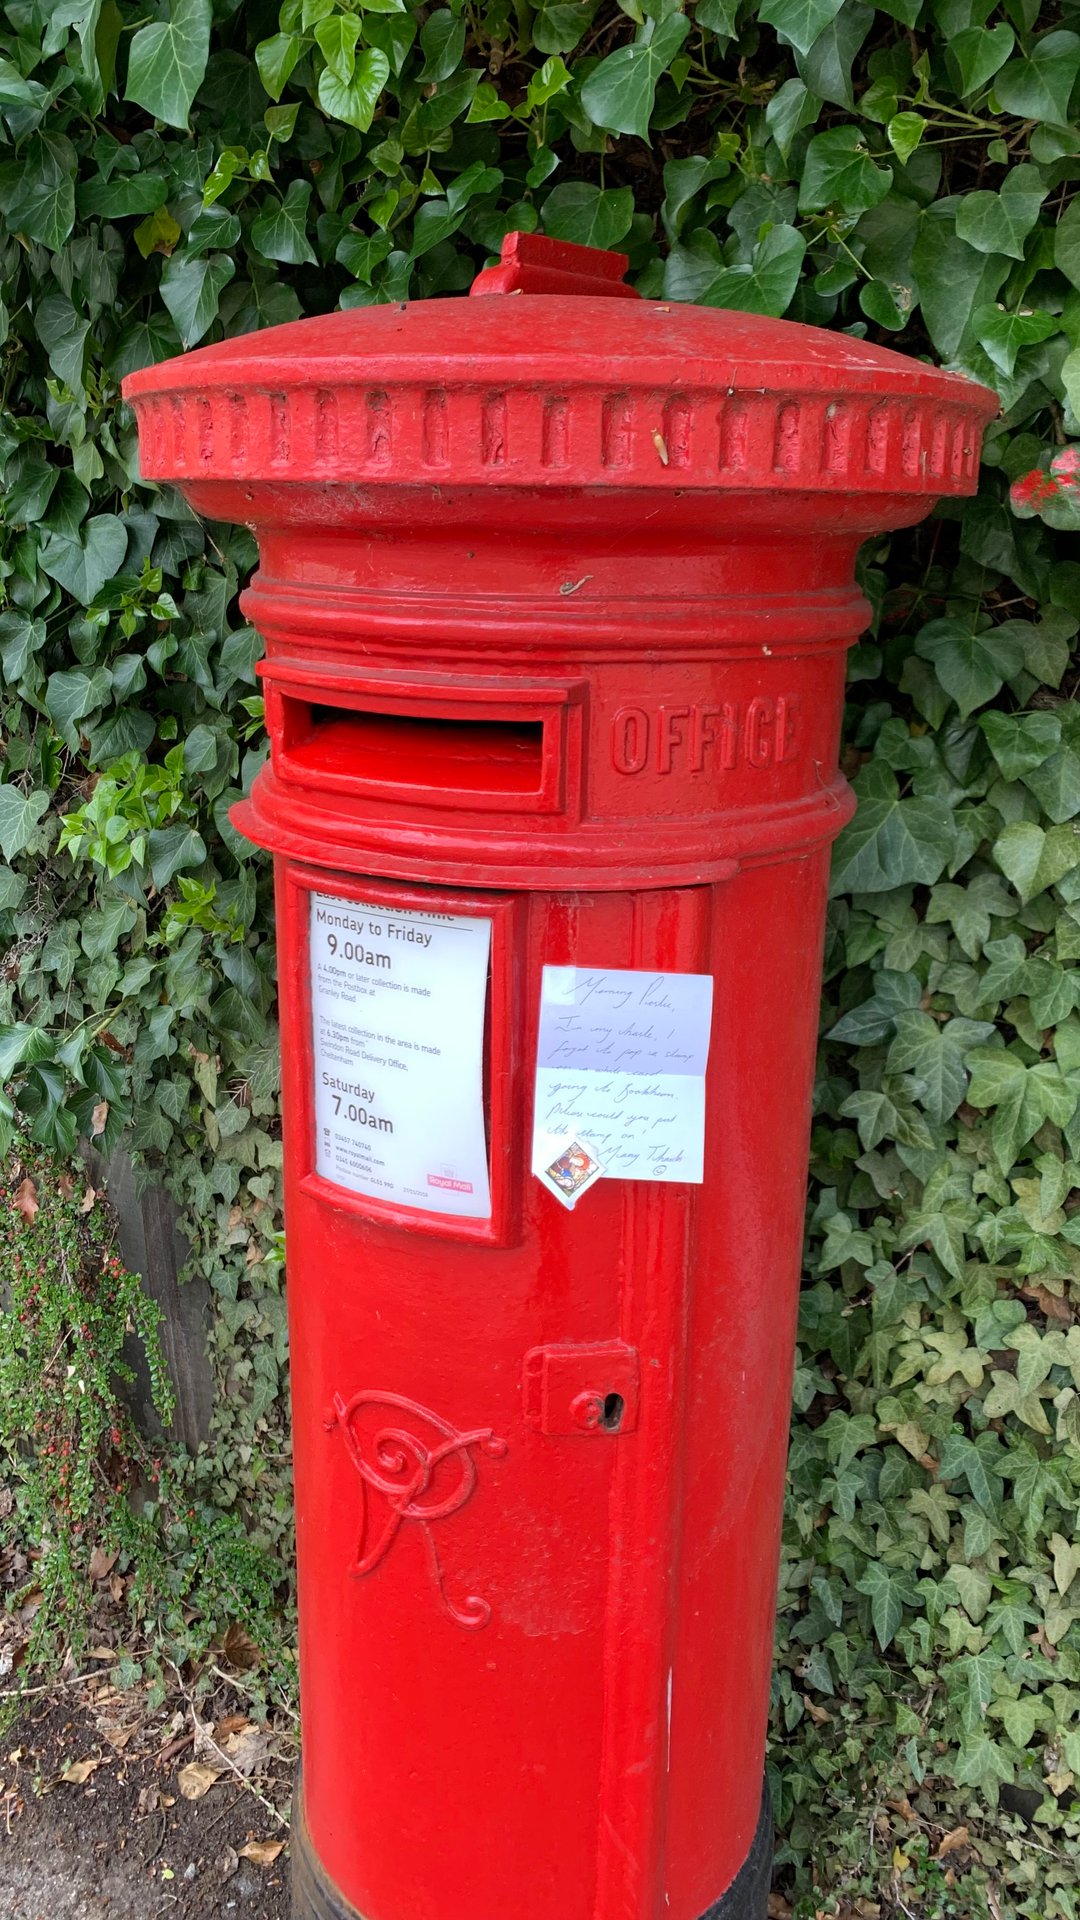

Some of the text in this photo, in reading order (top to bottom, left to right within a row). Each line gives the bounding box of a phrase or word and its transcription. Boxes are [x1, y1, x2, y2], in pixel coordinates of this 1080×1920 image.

[610, 696, 799, 775] OFFICE
[316, 909, 433, 948] Monday to Friday
[327, 933, 392, 969] 9.00am
[318, 974, 331, 984] from
[333, 979, 342, 988] the
[344, 980, 368, 994] Postbox
[348, 972, 355, 980] or
[356, 973, 370, 983] later
[371, 977, 402, 991] collection
[403, 984, 409, 993] is
[411, 986, 431, 997] made
[320, 1015, 441, 1056] The latest collection in the area is made
[320, 1028, 326, 1036] at
[327, 1029, 350, 1044] 6.30pm
[591, 1027, 612, 1043] my
[320, 1038, 409, 1071] Swindon Road Delivery Office,
[547, 1041, 590, 1060] forgot
[596, 1042, 615, 1054] to
[615, 1049, 642, 1062] pop
[664, 1048, 694, 1063] stamp
[322, 1072, 375, 1103] Saturday
[548, 1082, 588, 1102] going
[595, 1081, 614, 1093] to
[332, 1094, 394, 1134] 7.00am
[546, 1101, 677, 1129] Please would you put
[547, 1123, 569, 1136] the
[576, 1128, 612, 1144] stamp
[335, 1146, 386, 1166] www.royalmail.com
[597, 1145, 640, 1168] Many
[429, 1175, 472, 1192] Royal Mail
